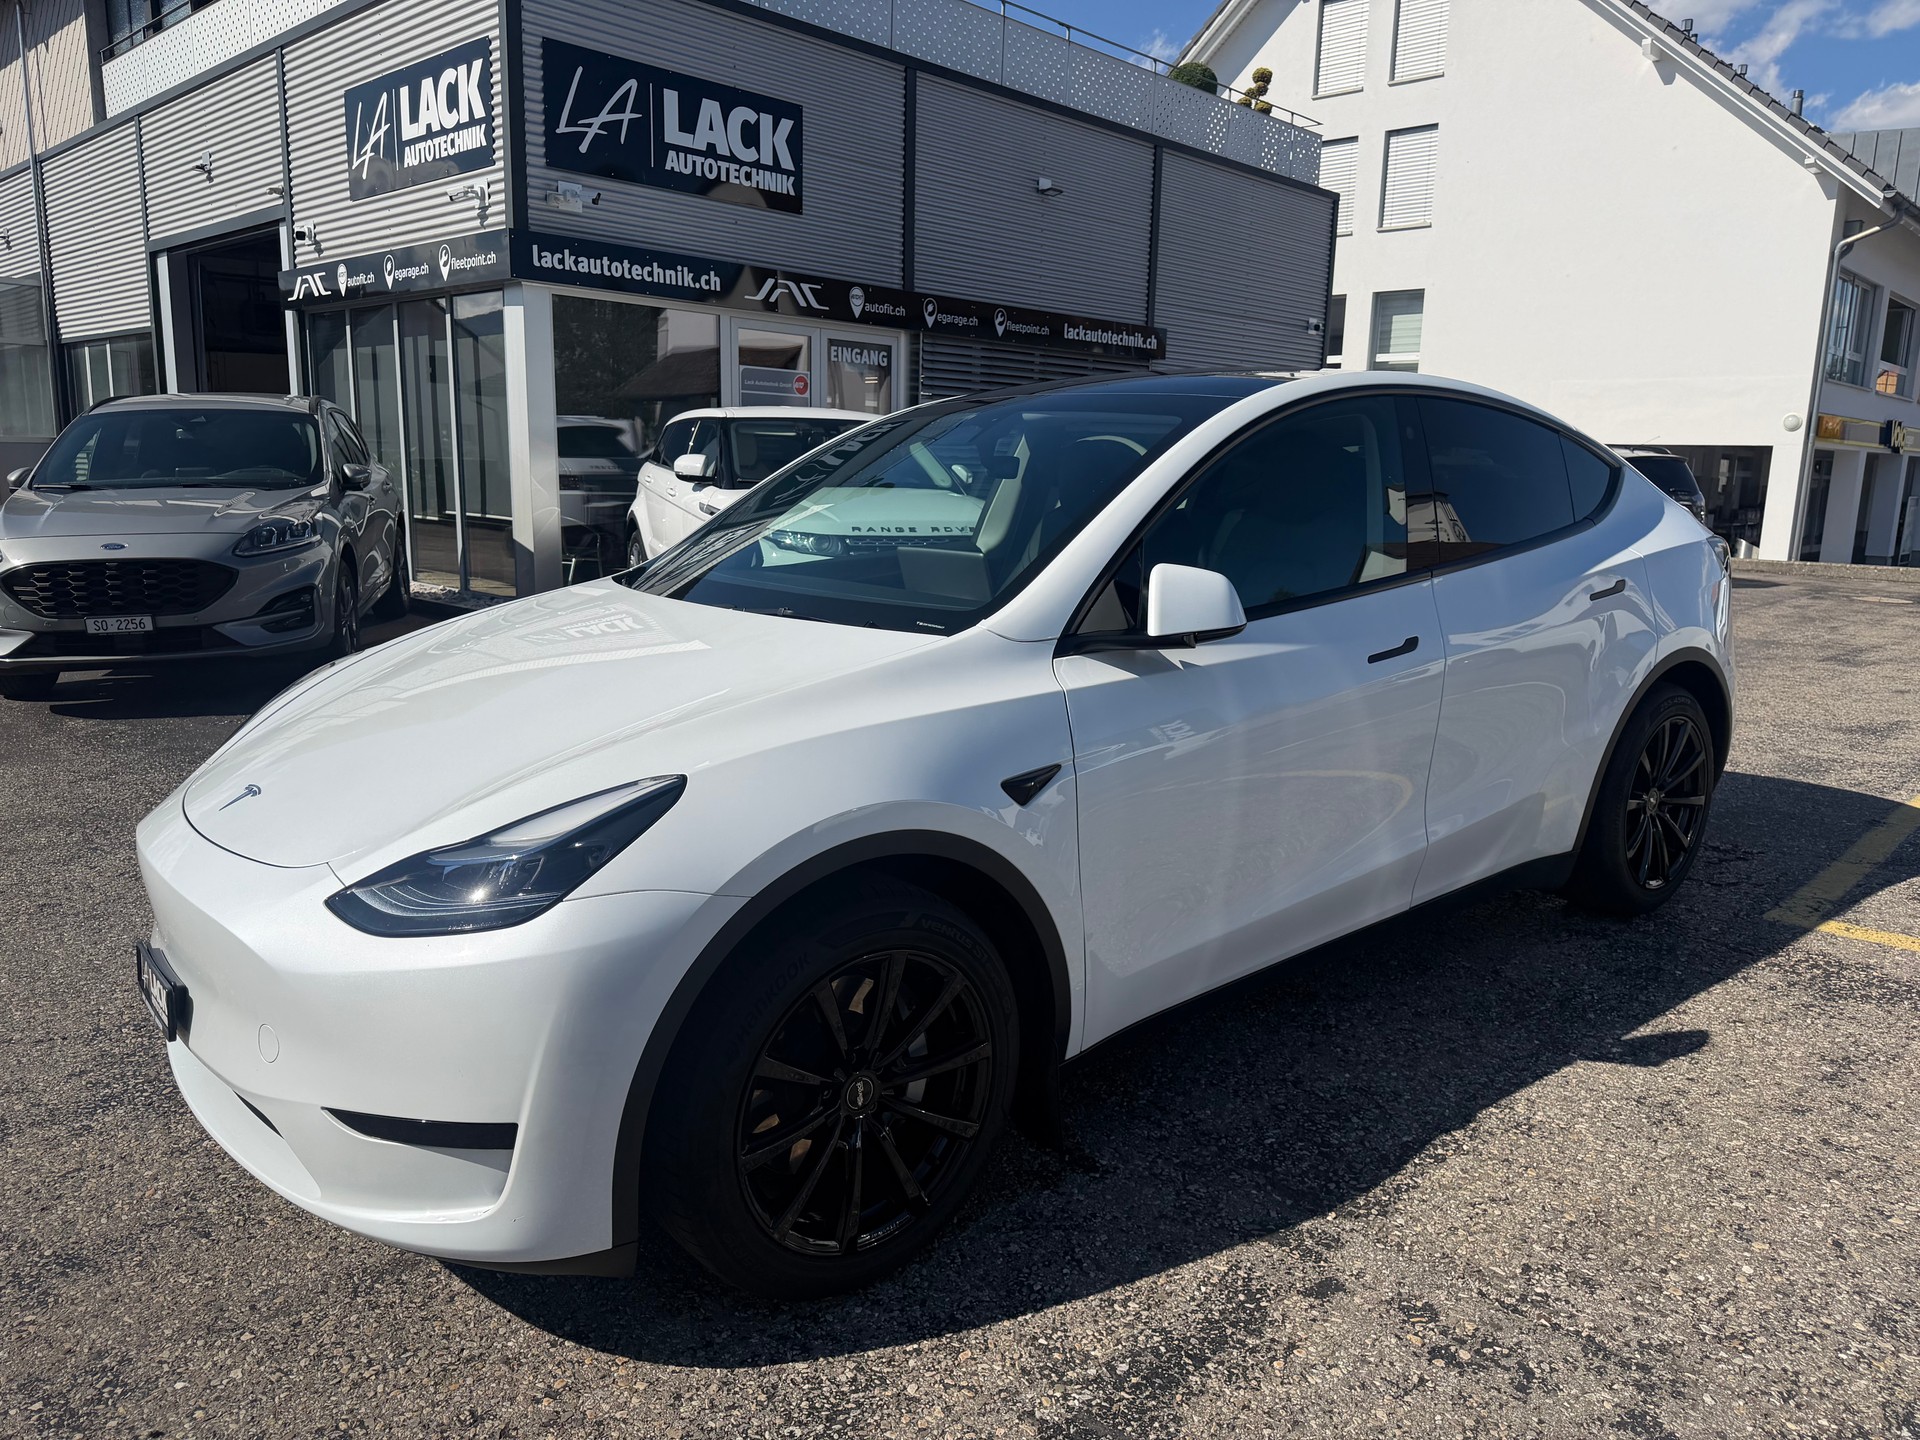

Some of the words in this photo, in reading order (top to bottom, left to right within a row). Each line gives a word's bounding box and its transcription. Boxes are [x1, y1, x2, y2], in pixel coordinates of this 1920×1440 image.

[400, 58, 486, 141] LACK
[663, 87, 796, 171] LACK
[404, 124, 487, 168] AUTOTECHNIK
[665, 150, 796, 197] AUTOTECHNIK
[394, 262, 429, 281] egarage.ch
[451, 251, 497, 270] fleetpoint.ch
[532, 244, 721, 292] lackautotechnik.ch
[347, 272, 375, 287] autofit.ch
[864, 303, 906, 317] autofit.ch
[937, 313, 979, 327] egarage.ch
[1006, 320, 1050, 336] fleetpoint.ch
[1063, 322, 1158, 350] lackautotechnik.ch
[830, 345, 888, 367] EINGANG
